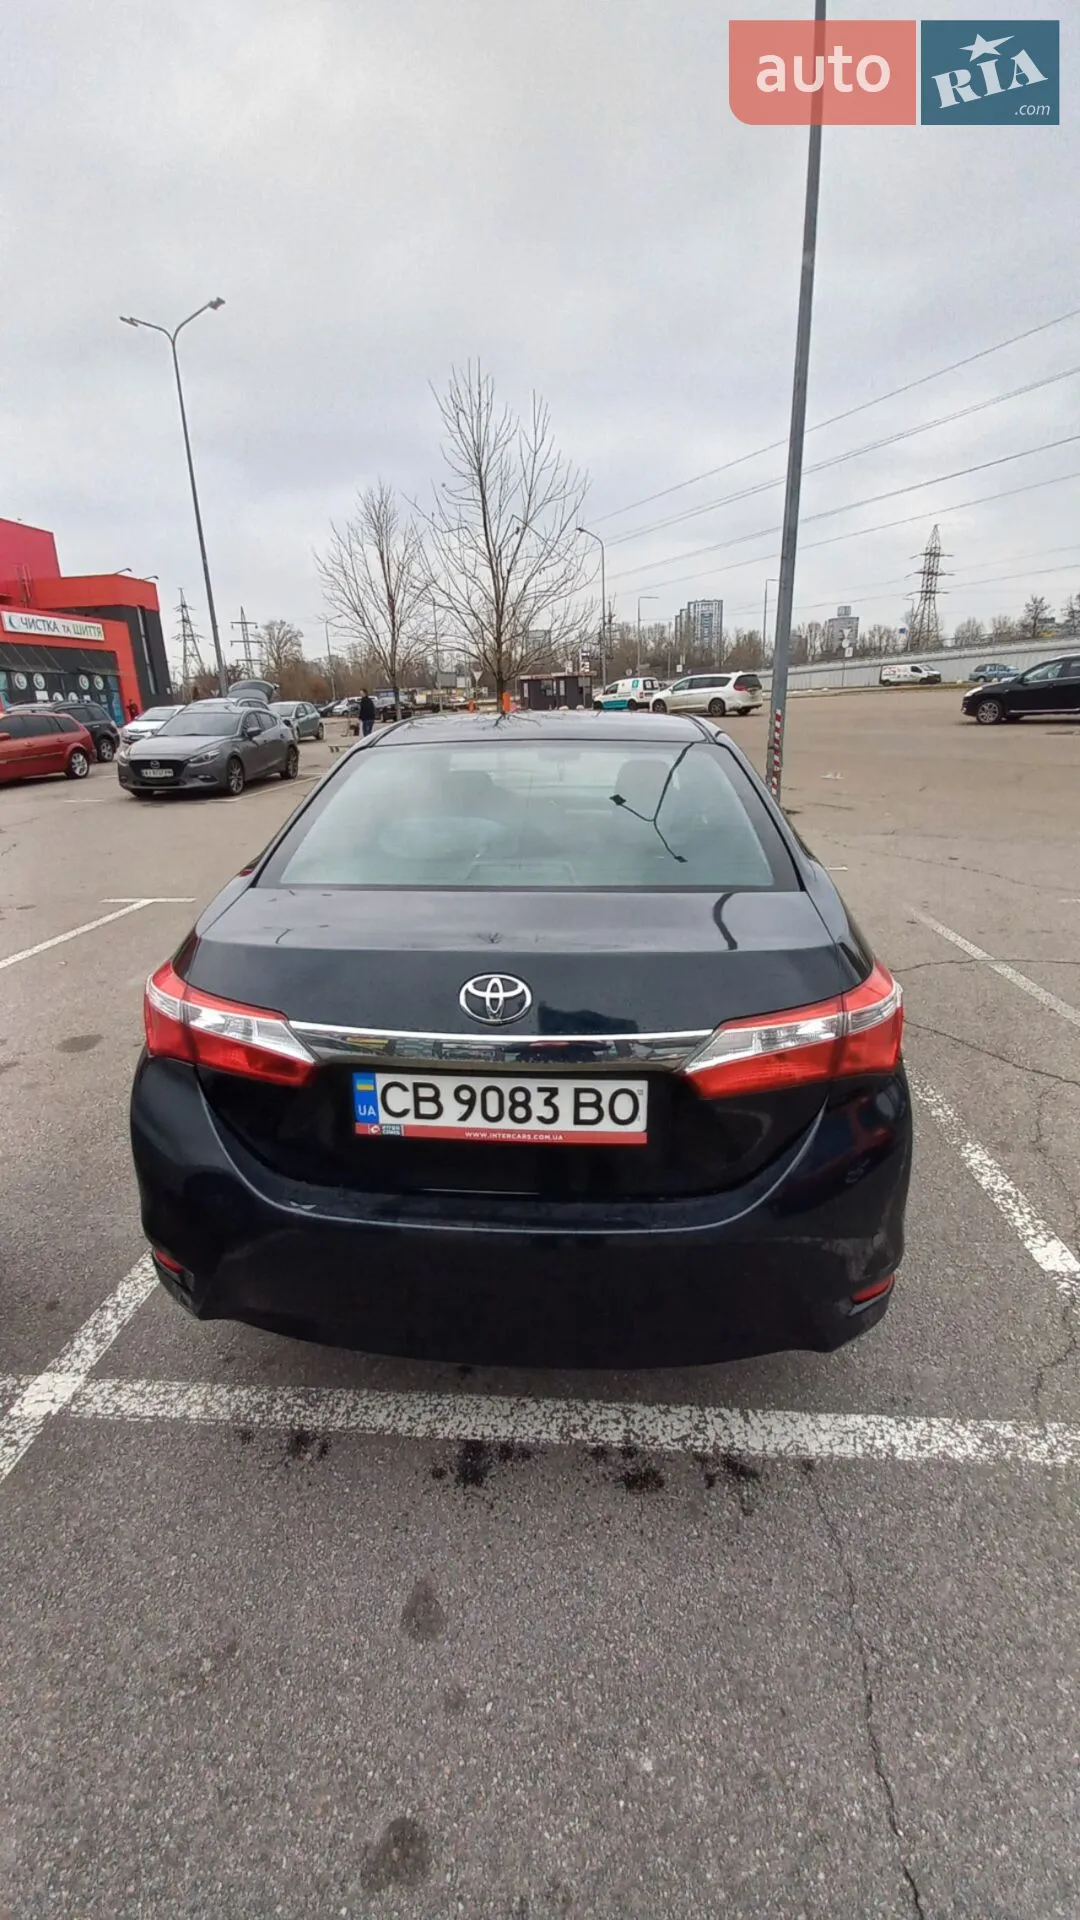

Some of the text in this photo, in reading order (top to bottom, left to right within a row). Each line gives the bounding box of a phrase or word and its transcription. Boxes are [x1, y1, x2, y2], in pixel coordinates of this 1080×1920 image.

[20, 617, 60, 633] ЧИСТКА
[72, 623, 103, 637] ШИТТЯ
[358, 1104, 377, 1117] UA
[380, 1081, 640, 1126] CB 9083 BO
[464, 1131, 564, 1141] WWW.INTERCARS.COM.UA
